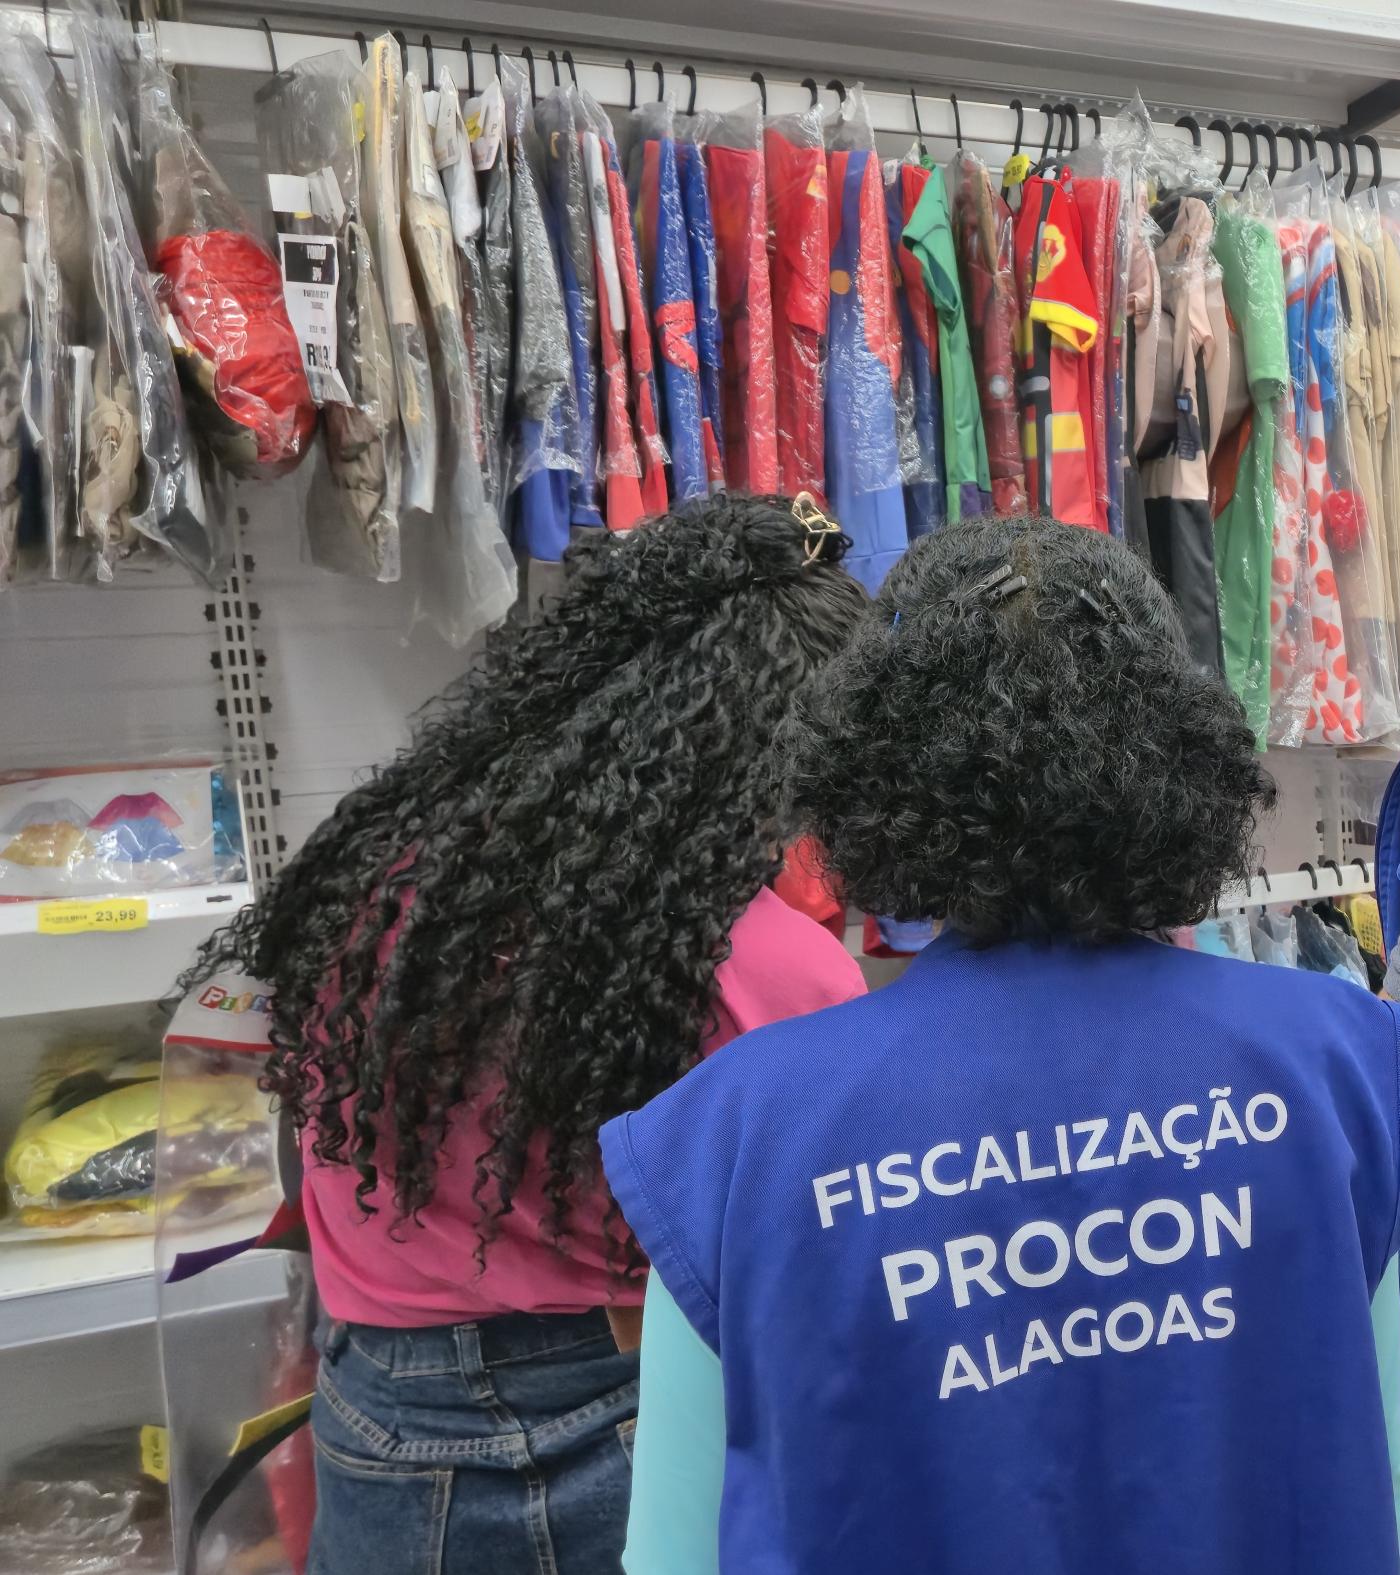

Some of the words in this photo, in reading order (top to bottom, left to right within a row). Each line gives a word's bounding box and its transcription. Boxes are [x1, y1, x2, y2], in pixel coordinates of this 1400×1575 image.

[95, 909, 137, 923] 23,99
[812, 1086, 1289, 1230] FISCALIZAÇÃO
[881, 1185, 1253, 1322] PROCON
[938, 1286, 1237, 1400] ALAGOAS
